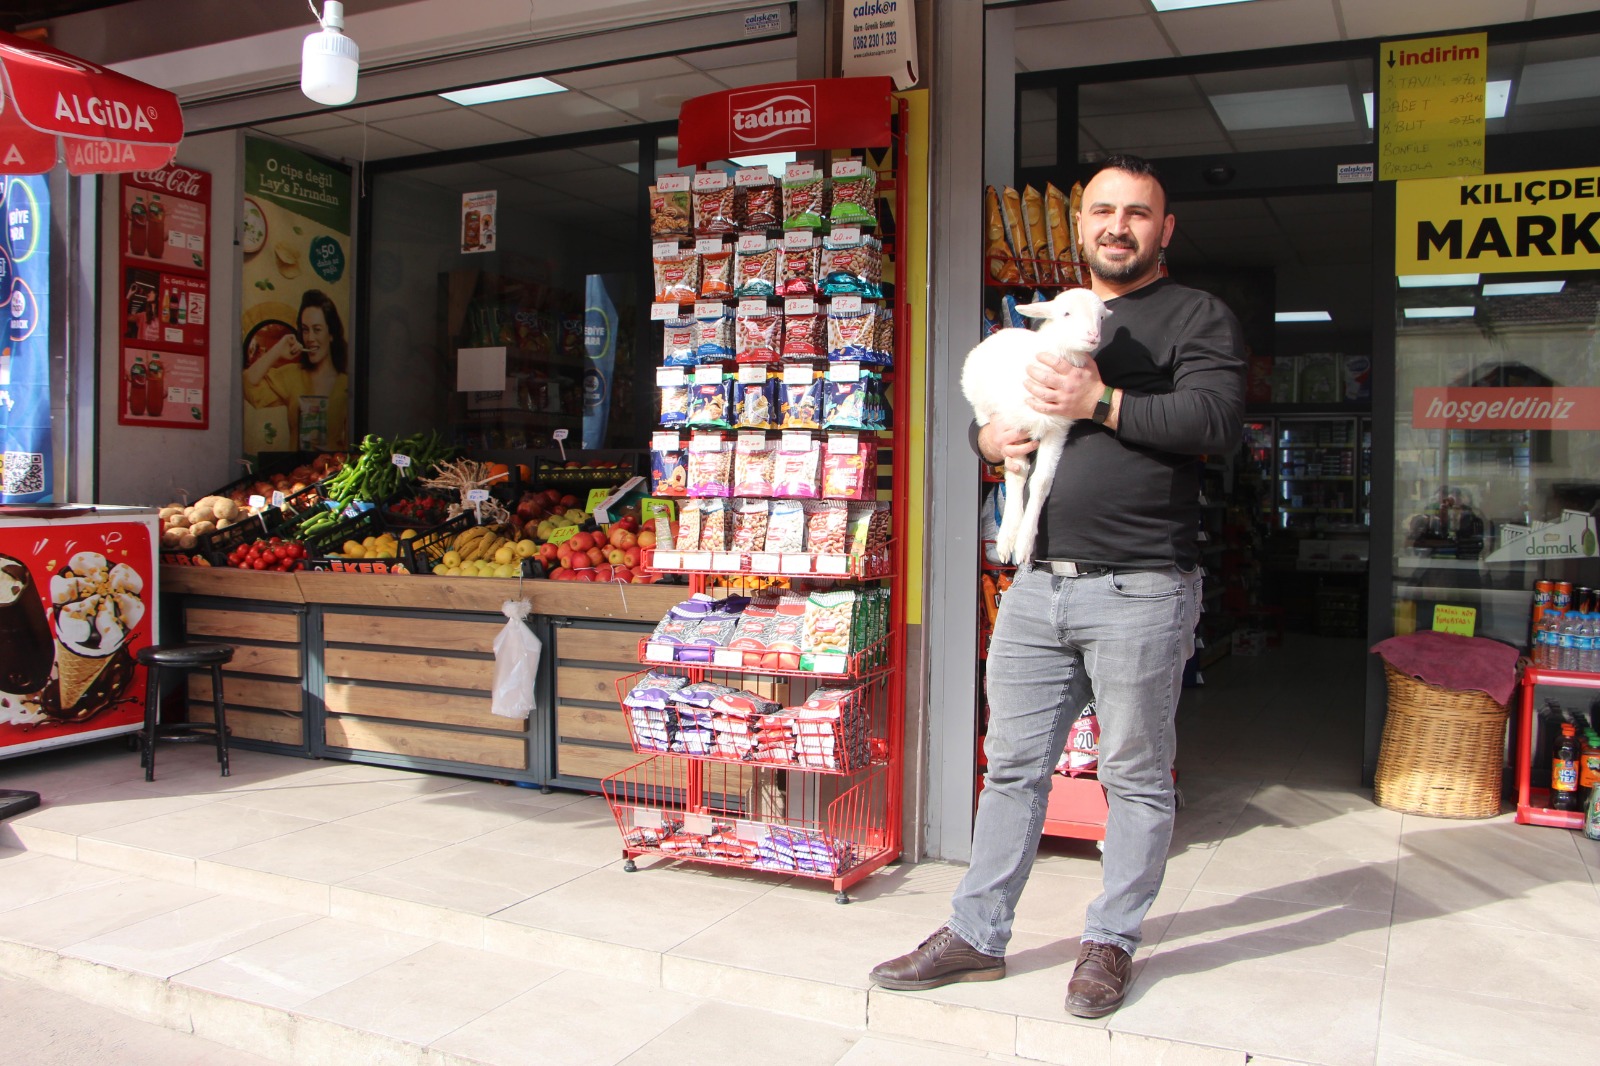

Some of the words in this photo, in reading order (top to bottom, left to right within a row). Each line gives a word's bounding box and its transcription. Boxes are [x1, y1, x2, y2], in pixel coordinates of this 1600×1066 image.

[852, 35, 868, 50] 0362
[868, 33, 879, 48] 230
[881, 32, 884, 46] 1
[885, 30, 897, 46] 333
[1399, 45, 1480, 67] indirim
[733, 106, 812, 131] tadım
[266, 158, 279, 172] O
[280, 163, 304, 181] cips
[305, 168, 333, 189] değil
[1460, 176, 1600, 207] KILIÇDE
[1425, 396, 1576, 424] hoşgeldiniz
[1525, 534, 1578, 556] damak
